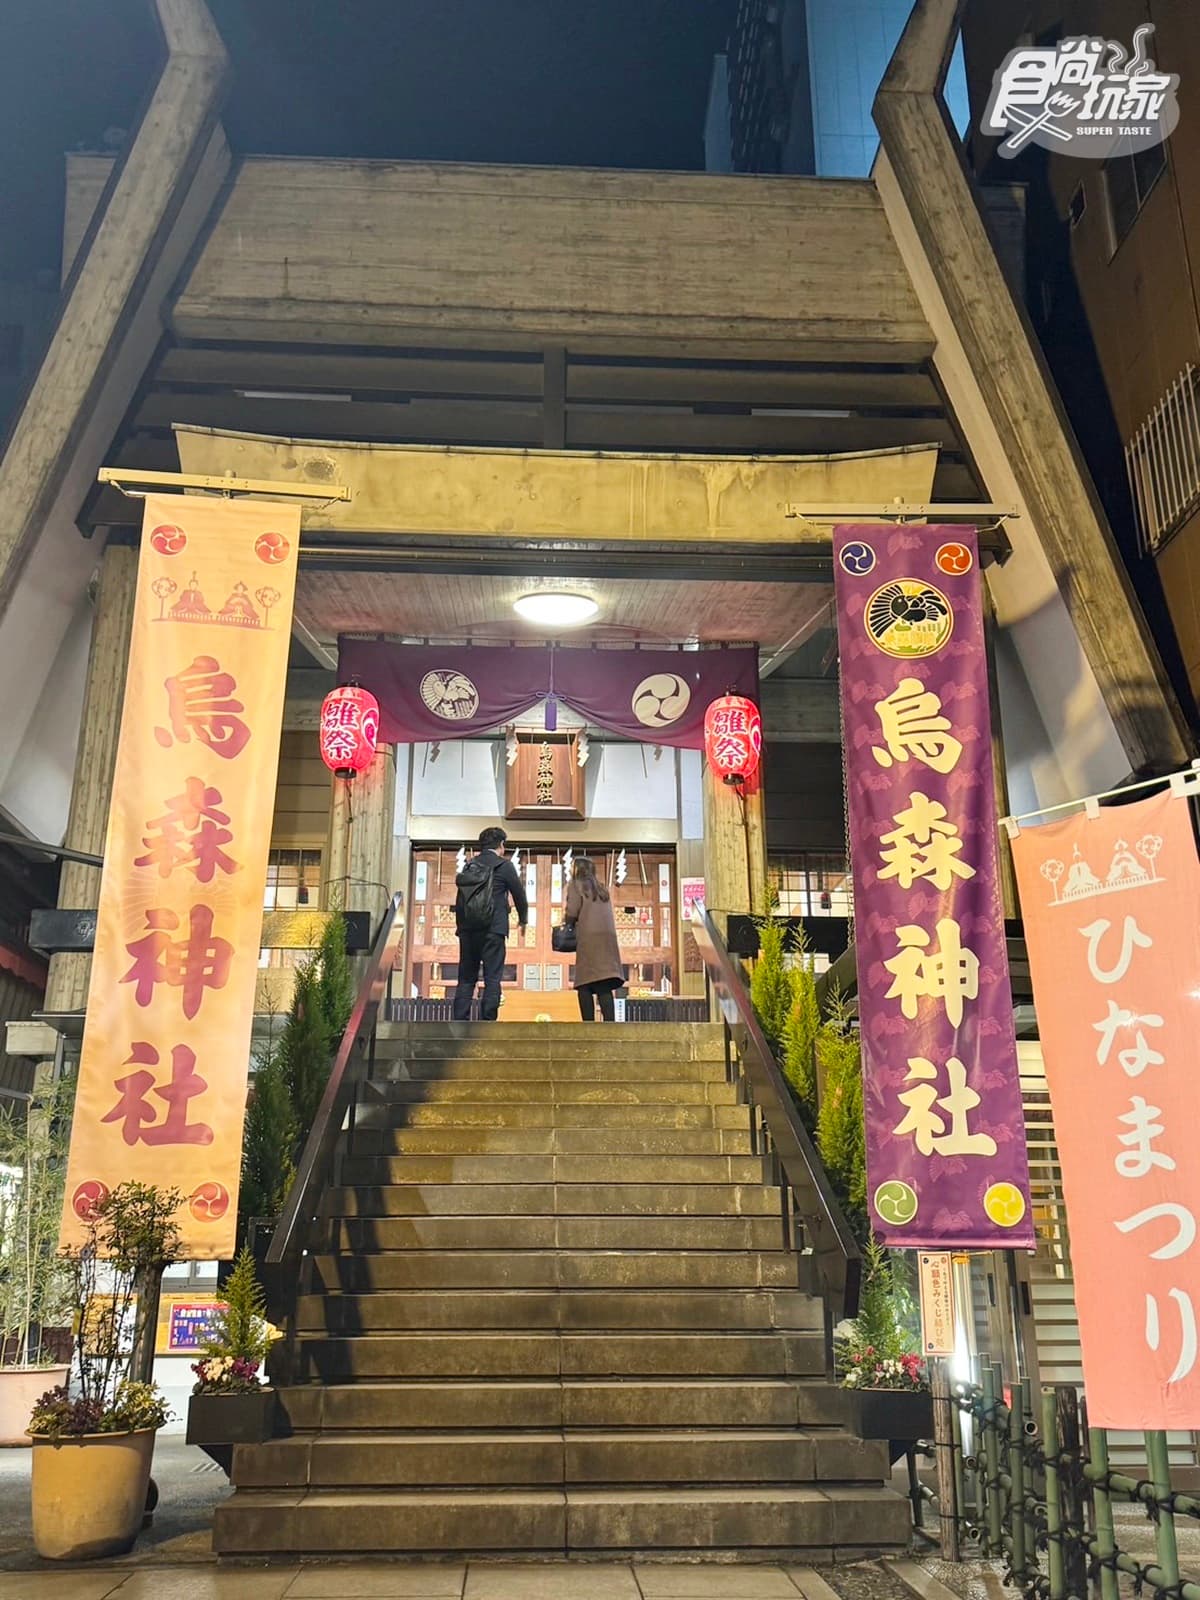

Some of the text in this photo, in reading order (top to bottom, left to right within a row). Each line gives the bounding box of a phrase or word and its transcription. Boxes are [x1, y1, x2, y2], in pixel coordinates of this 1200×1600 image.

[324, 700, 360, 760] 雛祭
[713, 709, 748, 768] 雛祭
[1077, 915, 1198, 1384] ひなまつり
